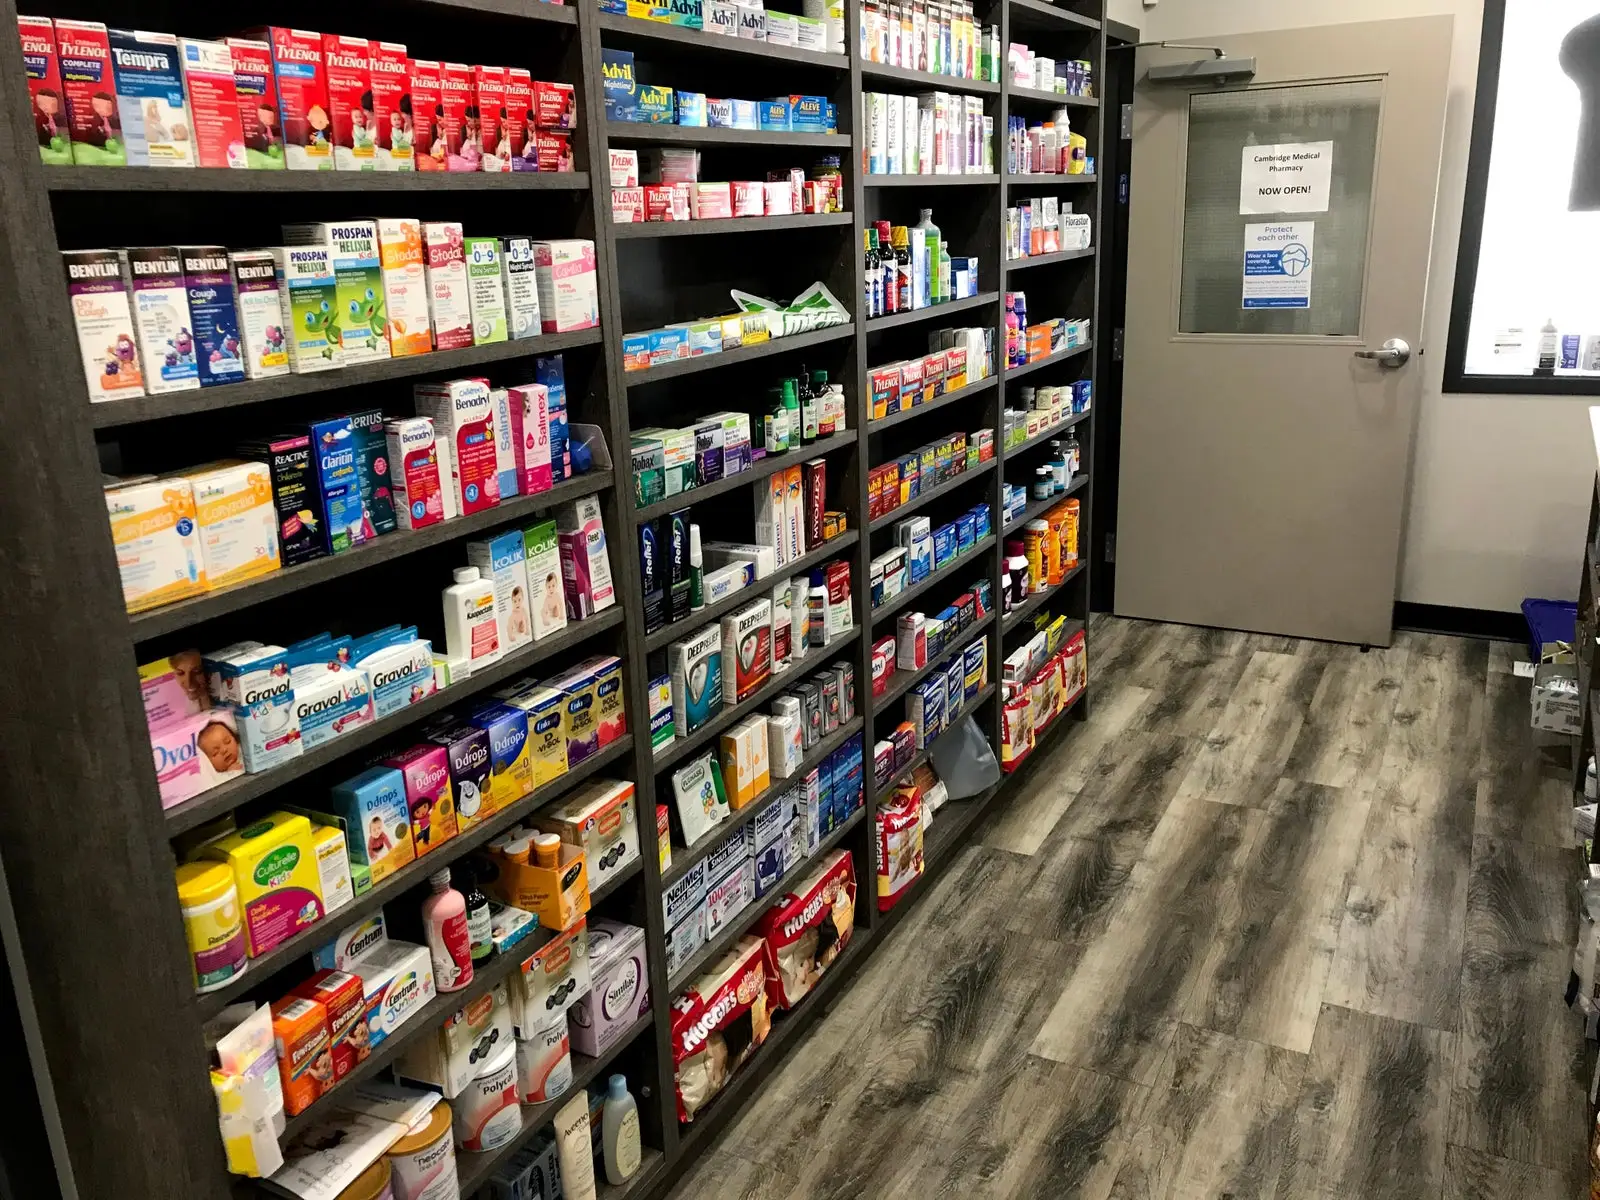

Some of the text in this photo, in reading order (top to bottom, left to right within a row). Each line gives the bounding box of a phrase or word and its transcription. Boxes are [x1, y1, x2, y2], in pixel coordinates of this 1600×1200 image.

[710, 9, 736, 26] Advil
[741, 13, 765, 29] Advil
[23, 41, 52, 53] ENOL
[59, 42, 108, 58] TYLENOL
[276, 44, 322, 62] TYLENOL
[62, 59, 101, 69] COMPLETE
[112, 47, 169, 70] Tempra
[231, 59, 270, 73] TYLENOL
[326, 52, 368, 70] TYLENOL
[368, 57, 407, 74] TYLENOL
[601, 62, 632, 79] Advil
[410, 76, 441, 90] TYLENOL
[440, 79, 469, 92] TYLENOL
[478, 81, 504, 93] TYLENOL
[504, 84, 531, 96] TYLENOL
[603, 79, 632, 91] Nighttime
[539, 92, 563, 103] TYLENOL
[639, 88, 668, 105] Advil
[710, 103, 730, 120] Nytol
[799, 101, 820, 112] ALEVE
[537, 138, 561, 149] TYLENOL
[611, 154, 634, 167] TYLENO
[1253, 152, 1320, 163] Cambridge Medical
[1268, 165, 1304, 173] Pharmacy
[1258, 185, 1311, 196] NOW OPEN!
[1065, 215, 1089, 227] Florastor
[331, 227, 373, 240] PROSPAN
[1257, 234, 1276, 242] each
[339, 239, 372, 253] HELIXIA
[430, 246, 463, 263] Stodal
[511, 247, 530, 260] 0-9
[290, 251, 328, 262] PROSPAN
[385, 247, 421, 264] Stodal
[473, 249, 494, 263] 0-9
[69, 262, 120, 279] BENYLIN
[133, 260, 180, 275] BENYLIN
[185, 257, 228, 272] BENYLIN
[237, 265, 275, 279] BENYLIN
[297, 261, 327, 274] HELIXIA
[189, 288, 217, 300] Cough
[926, 361, 943, 378] TYLENOL
[948, 355, 966, 370] TYLENOL
[875, 375, 899, 393] TYLENOL
[903, 368, 923, 385] TYLENOL
[455, 393, 490, 411] Benadryl
[499, 397, 511, 452] Salinex
[538, 391, 548, 446] Salinex
[402, 429, 433, 444] Benadryl
[274, 450, 310, 466] REACTINE
[322, 452, 353, 470] Claritin
[632, 455, 654, 472] Robax
[883, 467, 899, 484] Advil
[813, 474, 821, 539] MYOFLEX
[528, 536, 557, 557] KOLIK
[494, 549, 524, 570] KOLIK
[373, 660, 413, 688] Gravol
[245, 679, 291, 705] Gravol
[297, 690, 342, 719] Gravol
[494, 729, 525, 752] Ddrops
[455, 746, 488, 770] Ddrops
[415, 765, 447, 790] Ddrops
[366, 787, 398, 812] Ddrops
[756, 800, 782, 827] NeilMed
[256, 850, 297, 878] Culturelle
[269, 869, 293, 888] Kids
[667, 862, 704, 902] NeilMed
[707, 887, 724, 908] 100
[783, 891, 824, 939] HUGGIES
[349, 926, 383, 957] Centrum
[388, 979, 418, 1007] Centrum
[608, 975, 635, 1000] Similac
[385, 988, 420, 1024] Junior
[682, 990, 738, 1052] HUGGIES
[483, 1070, 514, 1095] Polycal
[563, 1112, 590, 1139] Aveeno
